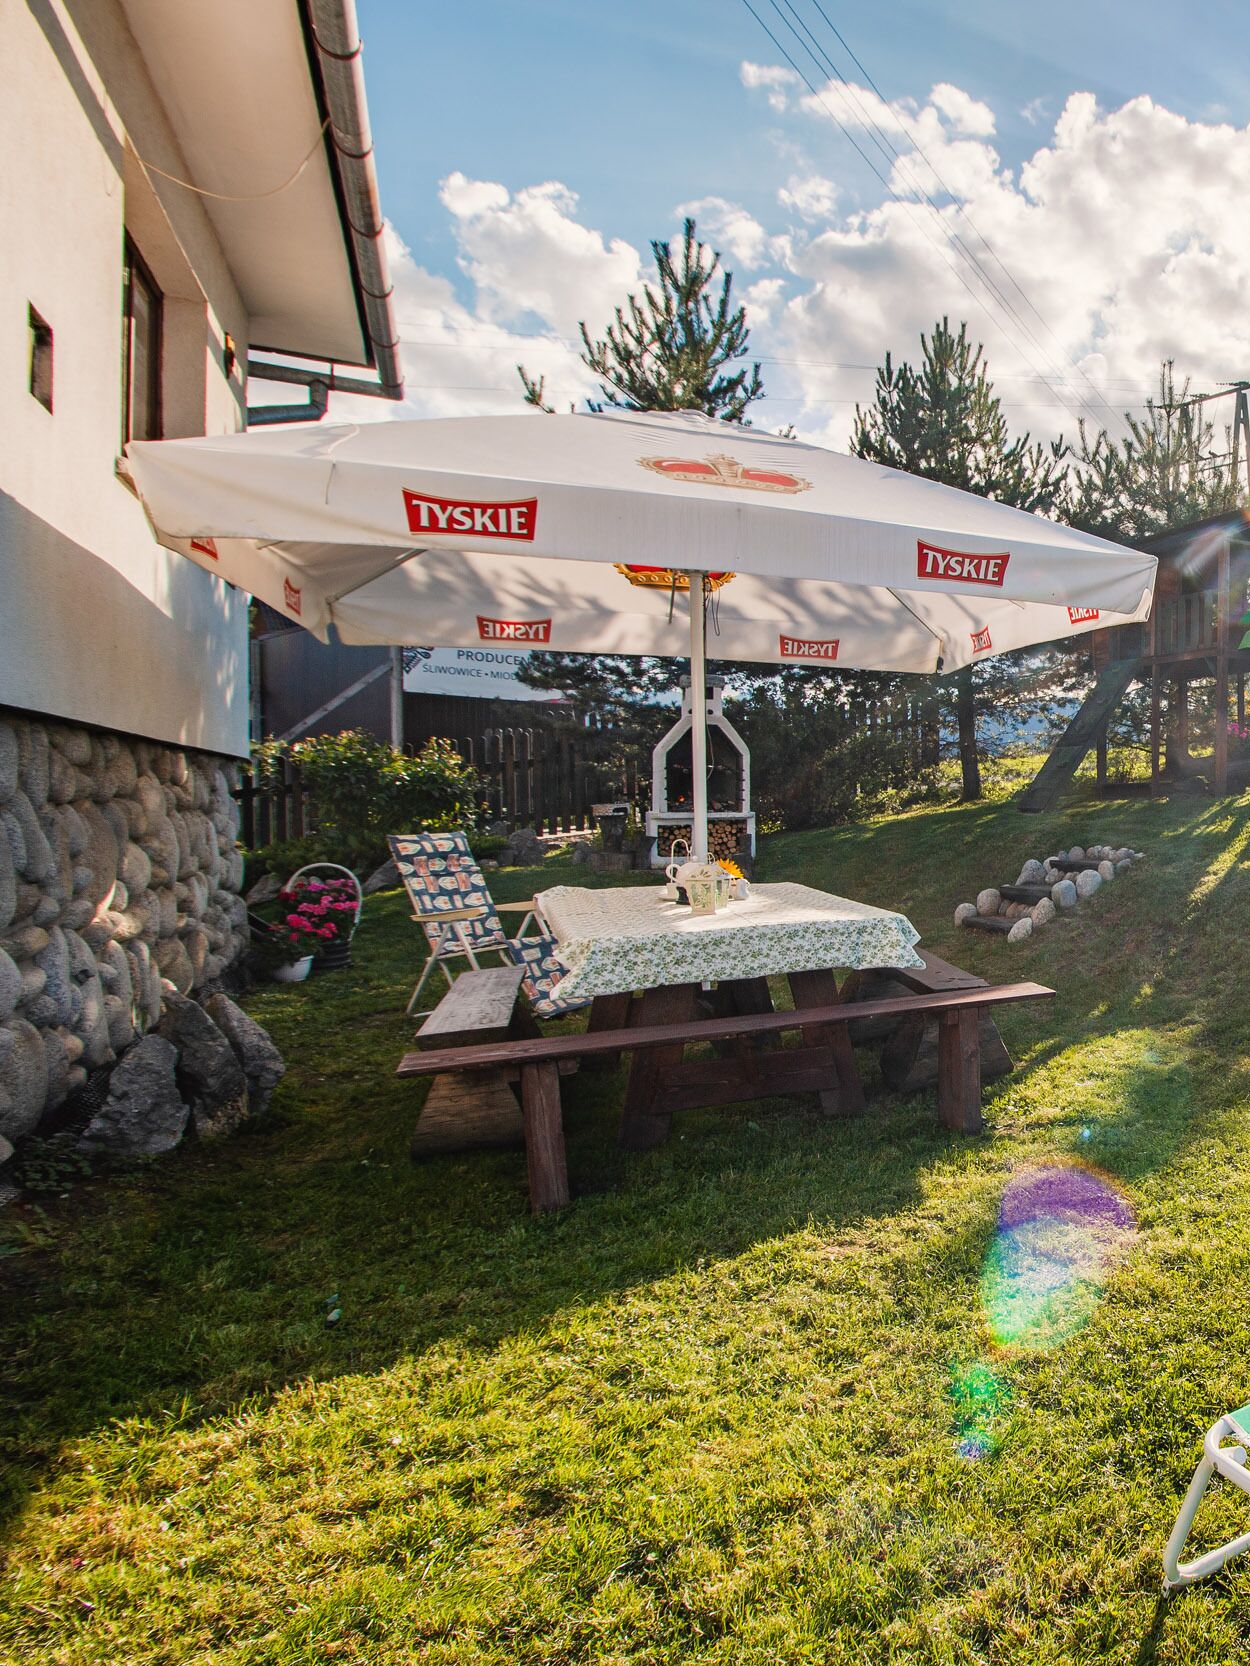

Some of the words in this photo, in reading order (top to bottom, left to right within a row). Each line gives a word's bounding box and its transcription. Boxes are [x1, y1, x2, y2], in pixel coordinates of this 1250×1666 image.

[411, 499, 529, 534] TYSKIE
[923, 548, 1002, 581] TYSKIE
[422, 663, 482, 678] ŚLIWOWICE
